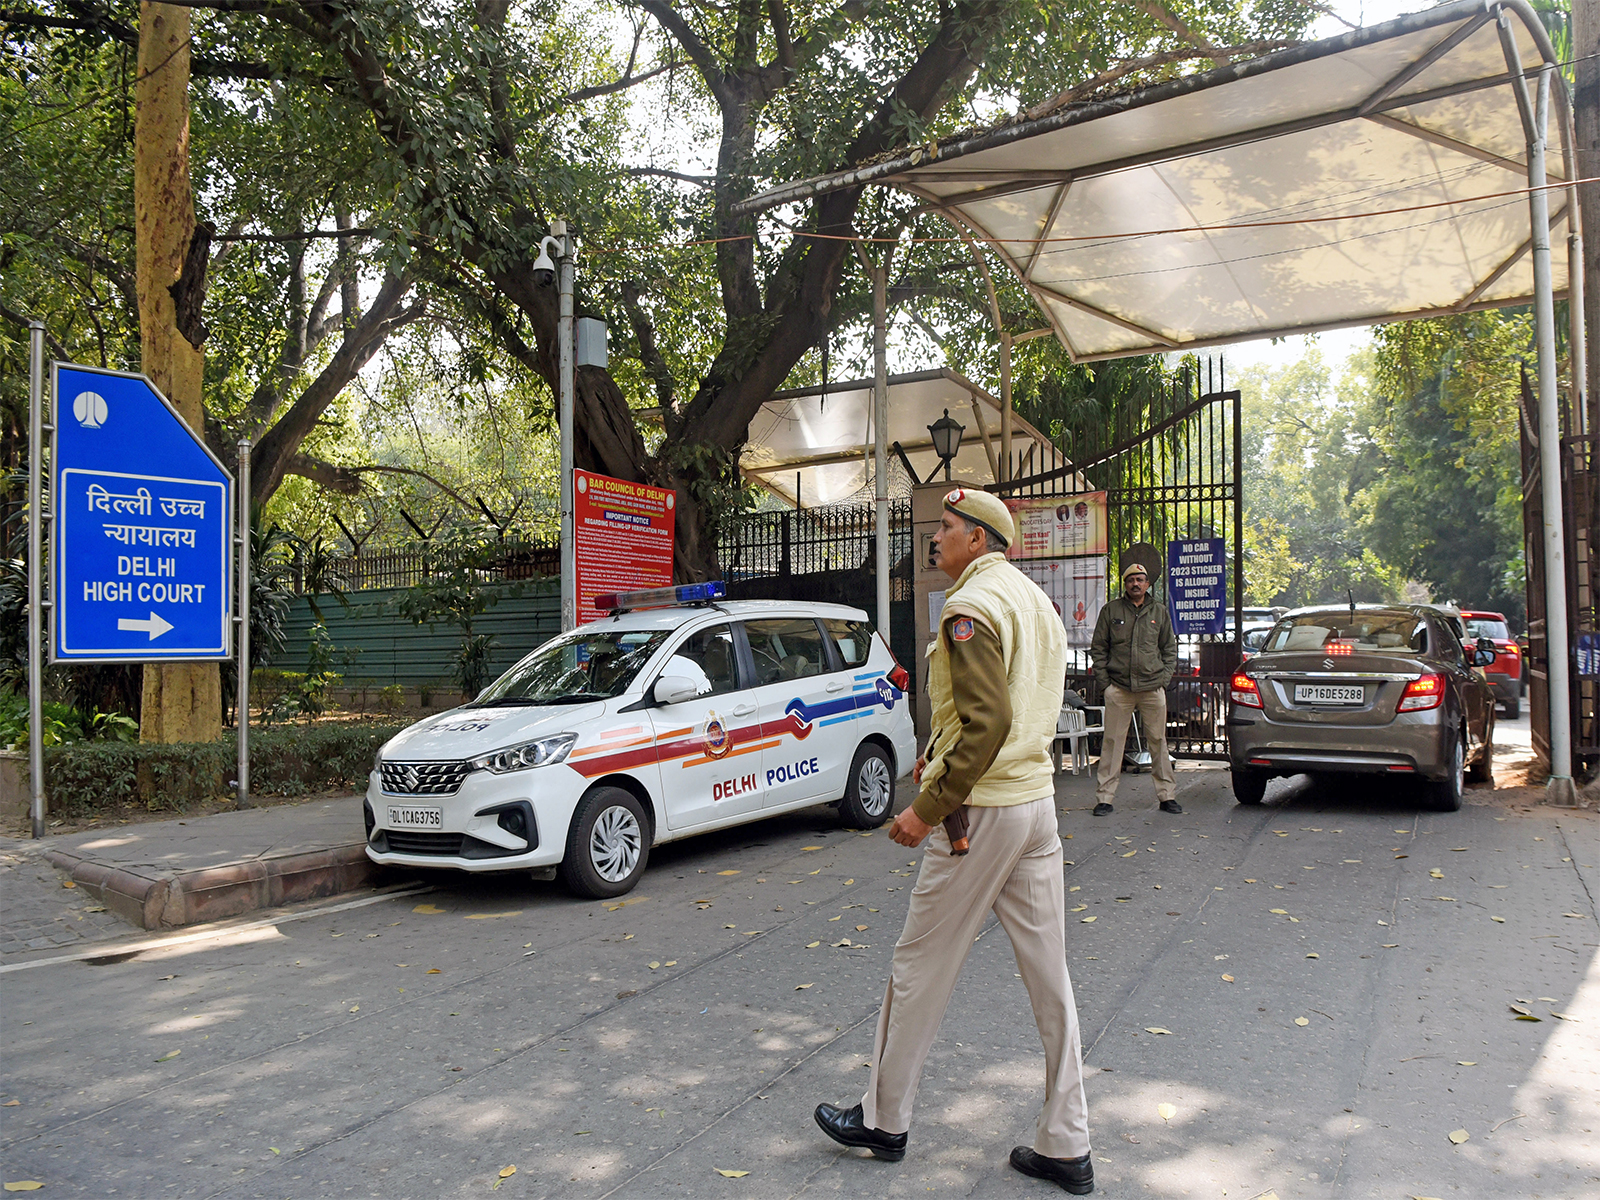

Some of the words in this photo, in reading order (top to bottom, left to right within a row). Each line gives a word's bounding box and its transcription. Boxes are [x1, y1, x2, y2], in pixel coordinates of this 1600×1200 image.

[589, 478, 604, 489] BAR
[605, 481, 635, 495] COUNCIL
[637, 488, 646, 498] OF
[647, 489, 665, 501] DELHI
[86, 483, 152, 516] दिल्ली
[159, 497, 206, 519] उच्च
[605, 511, 632, 523] IMPORTANT
[633, 516, 649, 525] NOTICE
[584, 517, 608, 527] REGARDING
[631, 524, 657, 534] VERIFICATION
[102, 523, 196, 548] न्यायालय
[1182, 543, 1193, 552] NO
[1194, 543, 1209, 552] CAR
[117, 555, 176, 577] DELHI
[1179, 554, 1213, 564] WITHOUT
[1170, 567, 1190, 576] 2023
[1191, 565, 1222, 575] STICKER
[1175, 578, 1184, 587] IS
[1184, 576, 1218, 587] ALLOWED
[83, 581, 132, 602] HIGH
[137, 582, 205, 603] COURT
[1184, 588, 1209, 598] INSIDE
[1175, 600, 1194, 609] HIGH
[1195, 599, 1220, 609] COURT
[1179, 611, 1215, 621] PREMISES
[1301, 688, 1362, 699] UP16DE5288
[712, 773, 757, 801] DELHI
[766, 757, 820, 786] POLICE
[392, 810, 440, 825] DL1CAG3756
